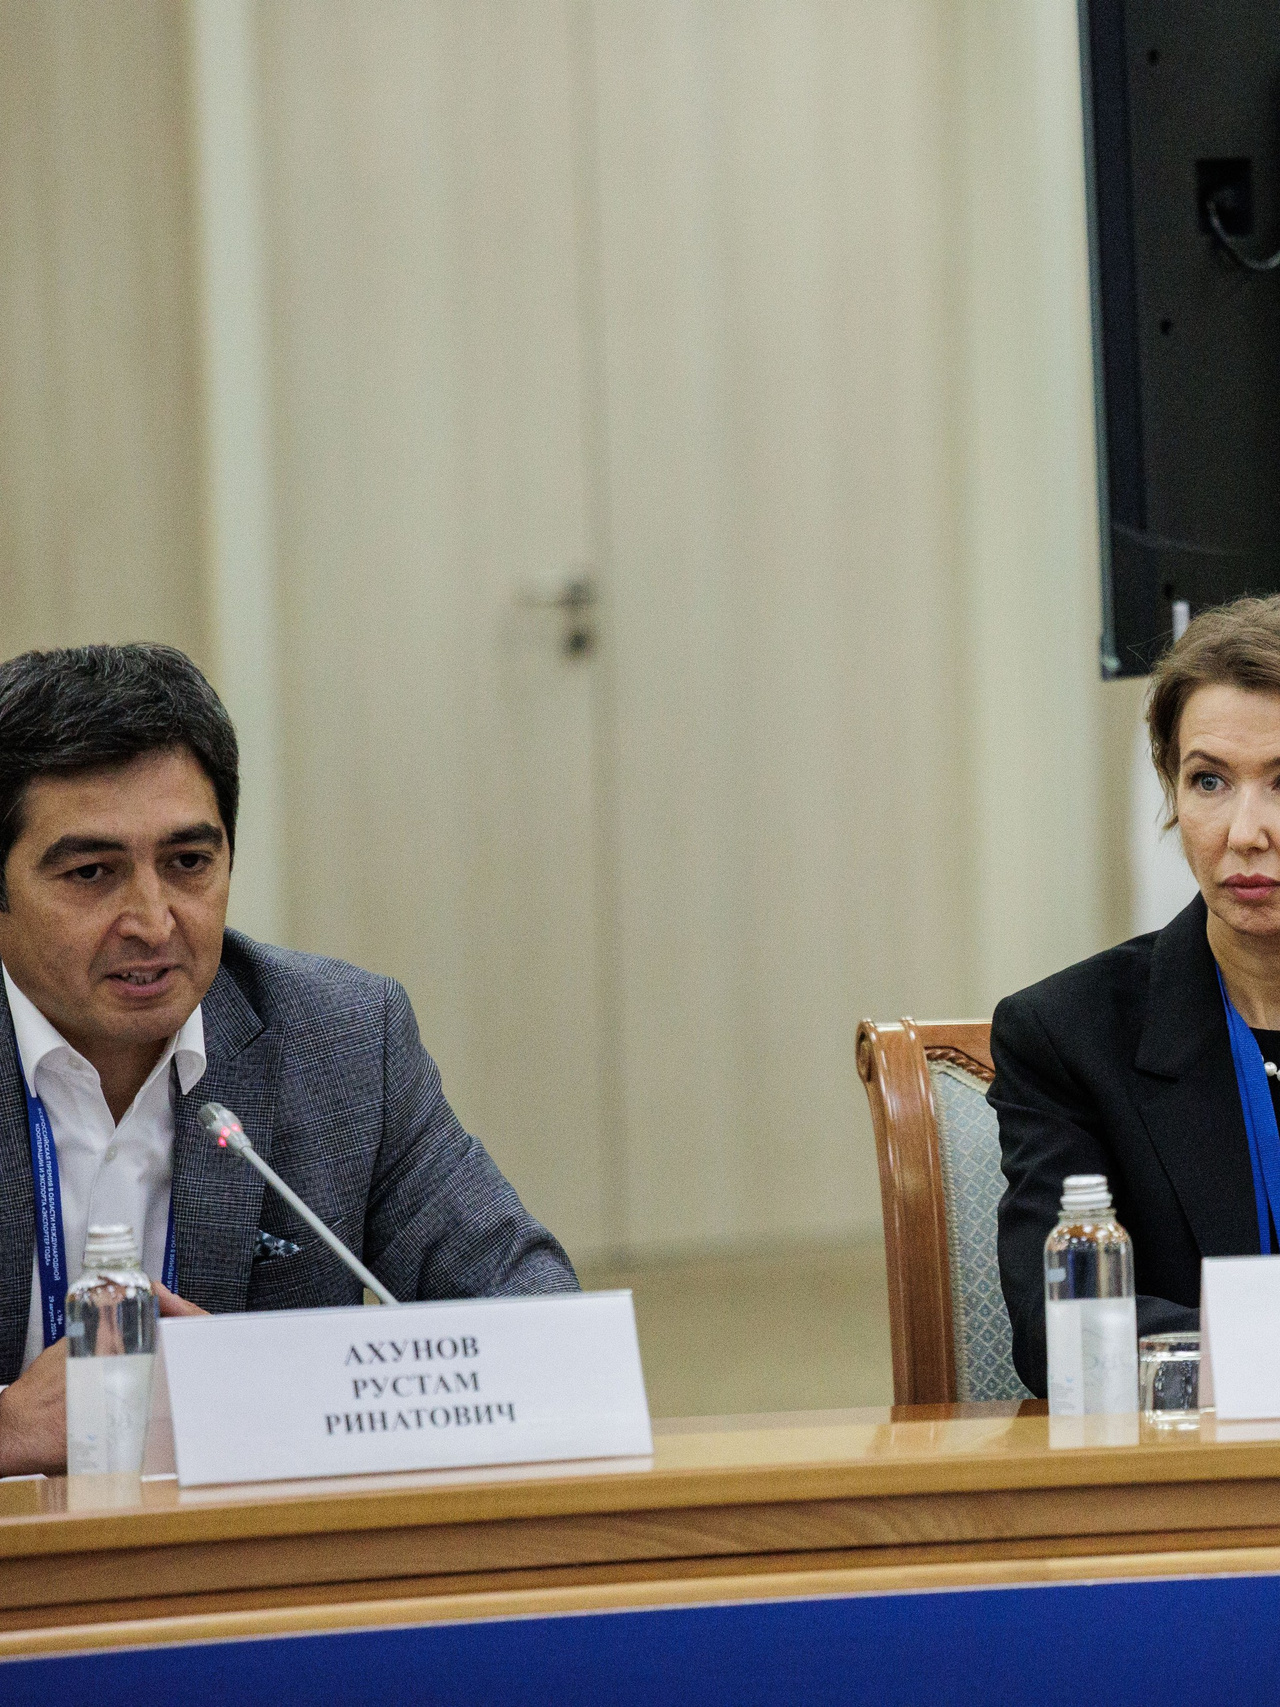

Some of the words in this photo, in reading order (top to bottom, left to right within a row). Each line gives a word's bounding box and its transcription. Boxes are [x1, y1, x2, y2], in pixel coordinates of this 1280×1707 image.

[35, 1123, 45, 1167] КООПЕРАЦИИ
[37, 1107, 51, 1160] ВСЕРОССИЙСКАЯ
[39, 1173, 47, 1206] ЭКСПОРТА
[45, 1161, 54, 1187] ПРЕМИЯ
[48, 1192, 56, 1222] ОБЛАСТИ
[41, 1207, 50, 1245] «ЭКСПОРТЕР
[50, 1223, 61, 1281] МЕЖДУНАРОДНОЙ
[167, 1253, 176, 1280] ПРЕМИЯ
[347, 1335, 480, 1366] АХУНОВ
[351, 1371, 480, 1400] РУСТАМ
[325, 1403, 517, 1436] РИНАТОВИЧ
